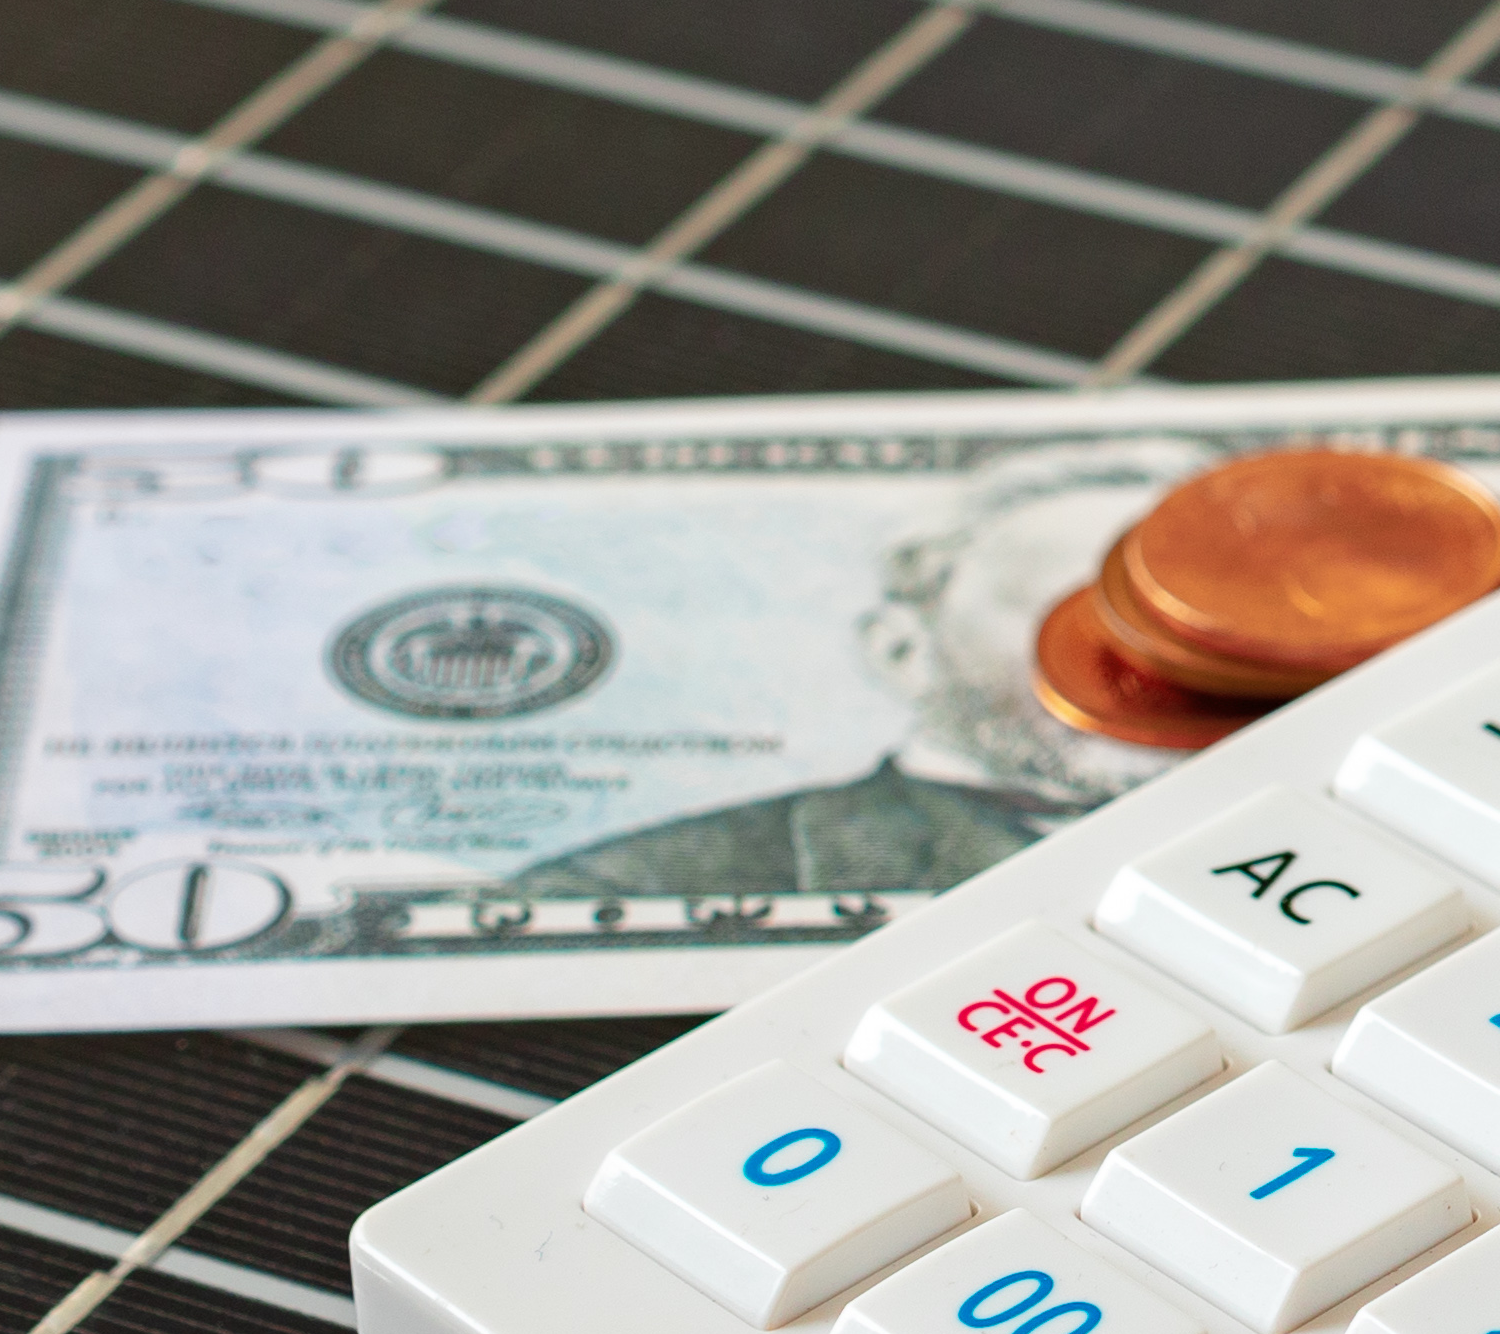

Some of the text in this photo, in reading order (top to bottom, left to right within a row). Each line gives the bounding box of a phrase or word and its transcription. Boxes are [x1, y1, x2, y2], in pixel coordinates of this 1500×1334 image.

[1212, 850, 1361, 925] AC
[1023, 976, 1117, 1035] ON
[741, 1127, 843, 1188] 0
[1248, 1146, 1336, 1201] 1
